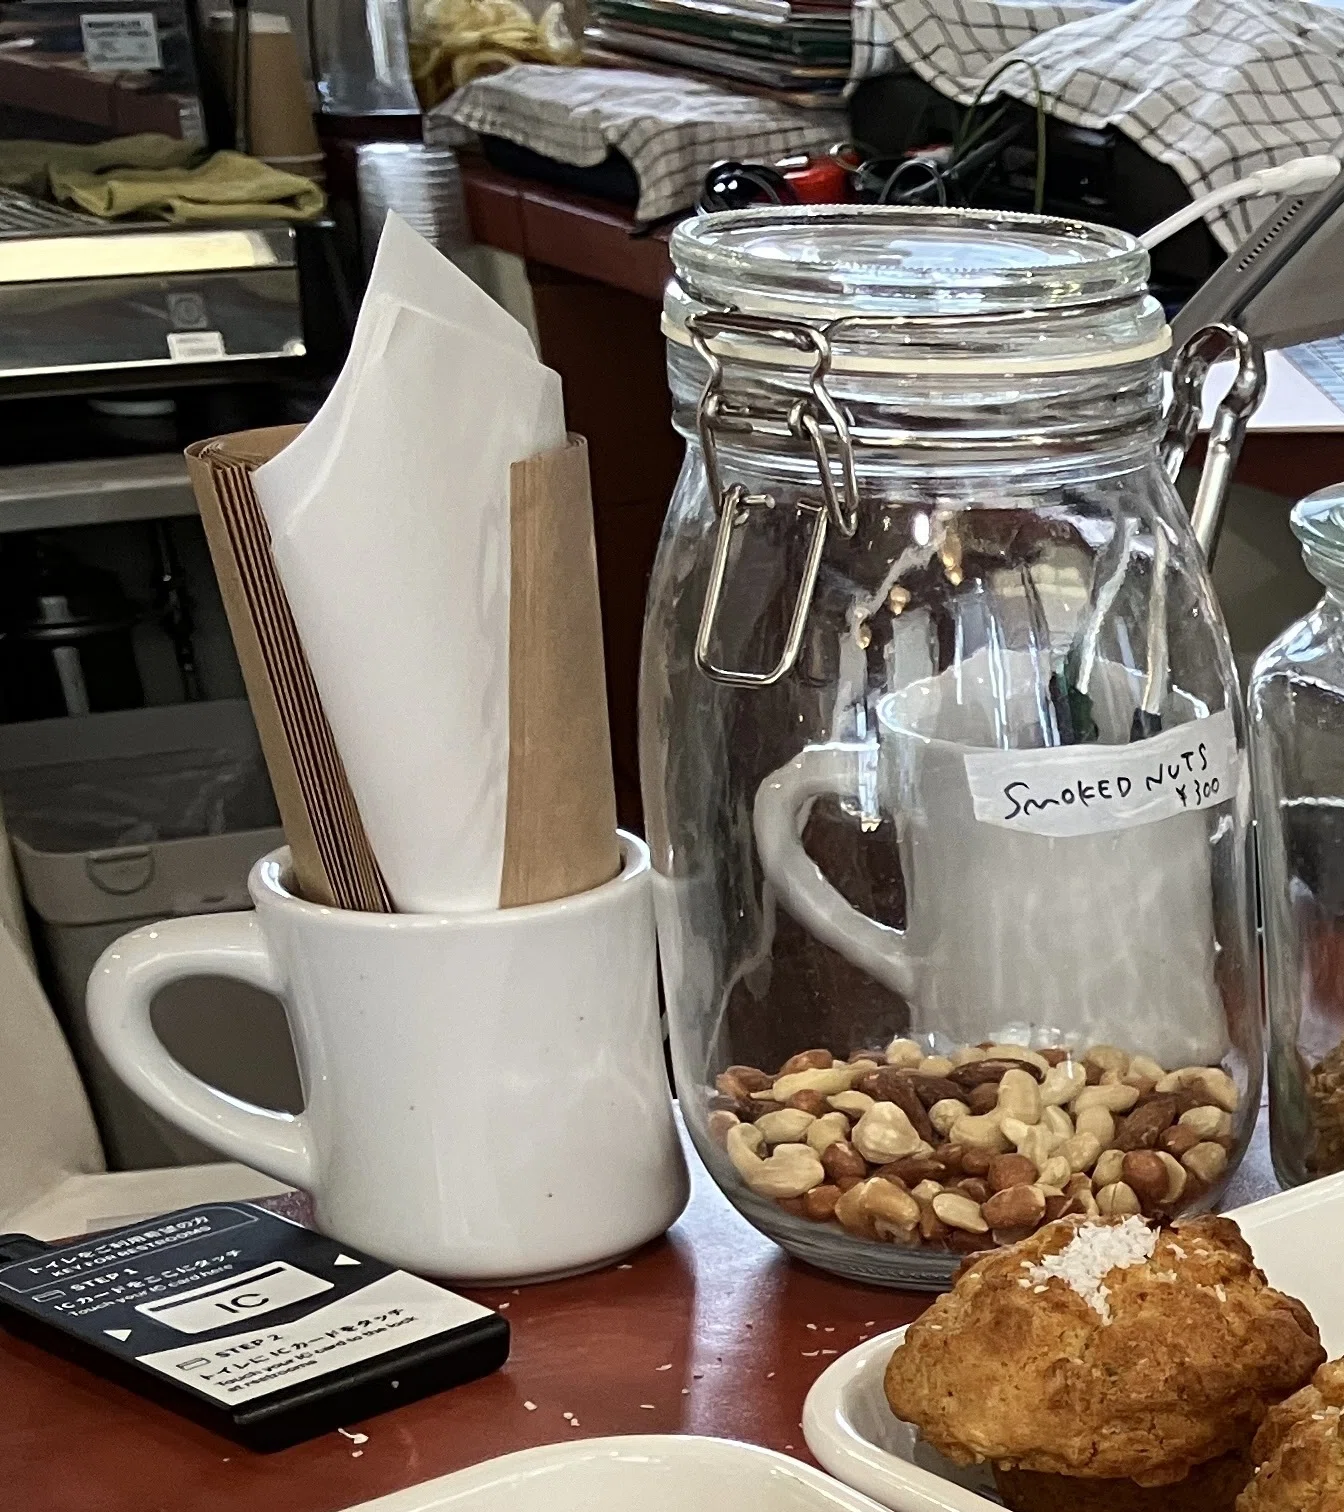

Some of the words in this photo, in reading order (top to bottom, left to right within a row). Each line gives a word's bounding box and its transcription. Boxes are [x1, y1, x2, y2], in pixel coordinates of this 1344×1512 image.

[1146, 742, 1209, 791] NUTS
[70, 1271, 119, 1291] STEP
[215, 1292, 270, 1314] IC
[215, 1338, 264, 1359] STEP
[267, 1333, 284, 1343] 2
